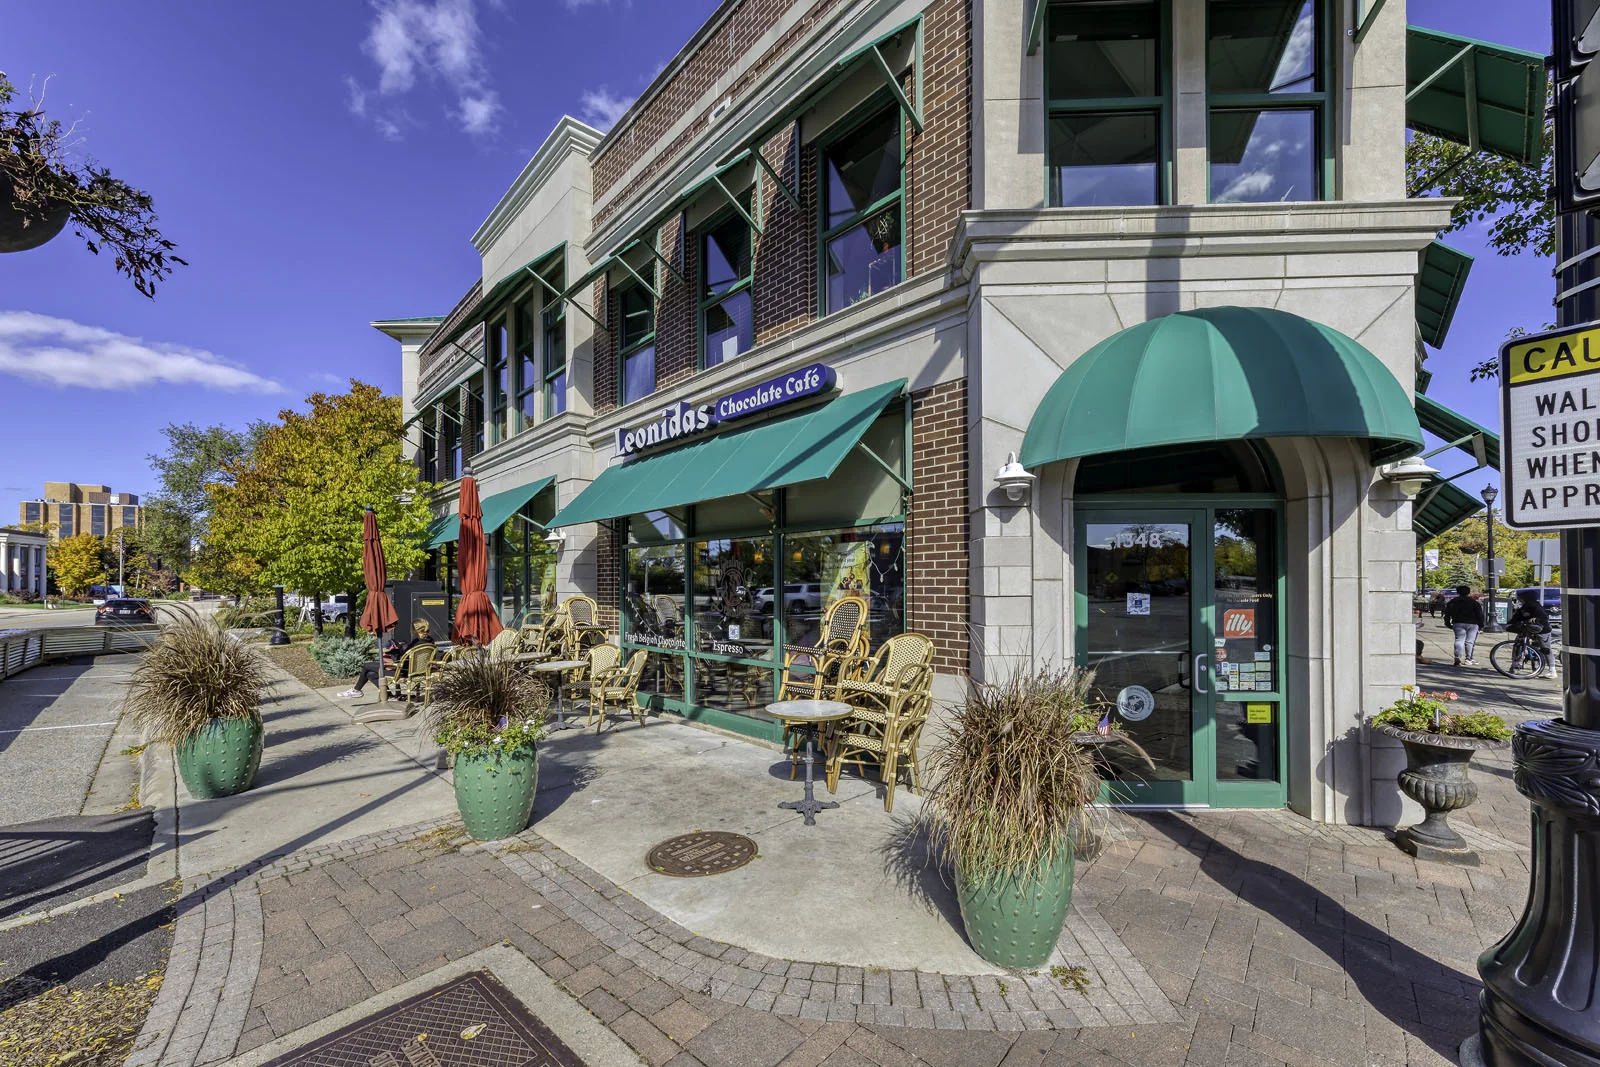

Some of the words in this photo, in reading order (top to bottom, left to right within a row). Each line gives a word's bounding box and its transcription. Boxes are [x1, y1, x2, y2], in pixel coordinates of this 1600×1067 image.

[614, 401, 709, 456] Leonidas
[719, 386, 782, 417] Chocolate
[786, 367, 820, 396] Café
[1535, 387, 1597, 417] WAL
[1531, 418, 1600, 448] SHO
[1520, 483, 1600, 511] APPR
[1115, 532, 1161, 548] 1348
[1225, 613, 1253, 636] illy
[624, 631, 639, 645] Fresh
[713, 640, 744, 655] Espresso
